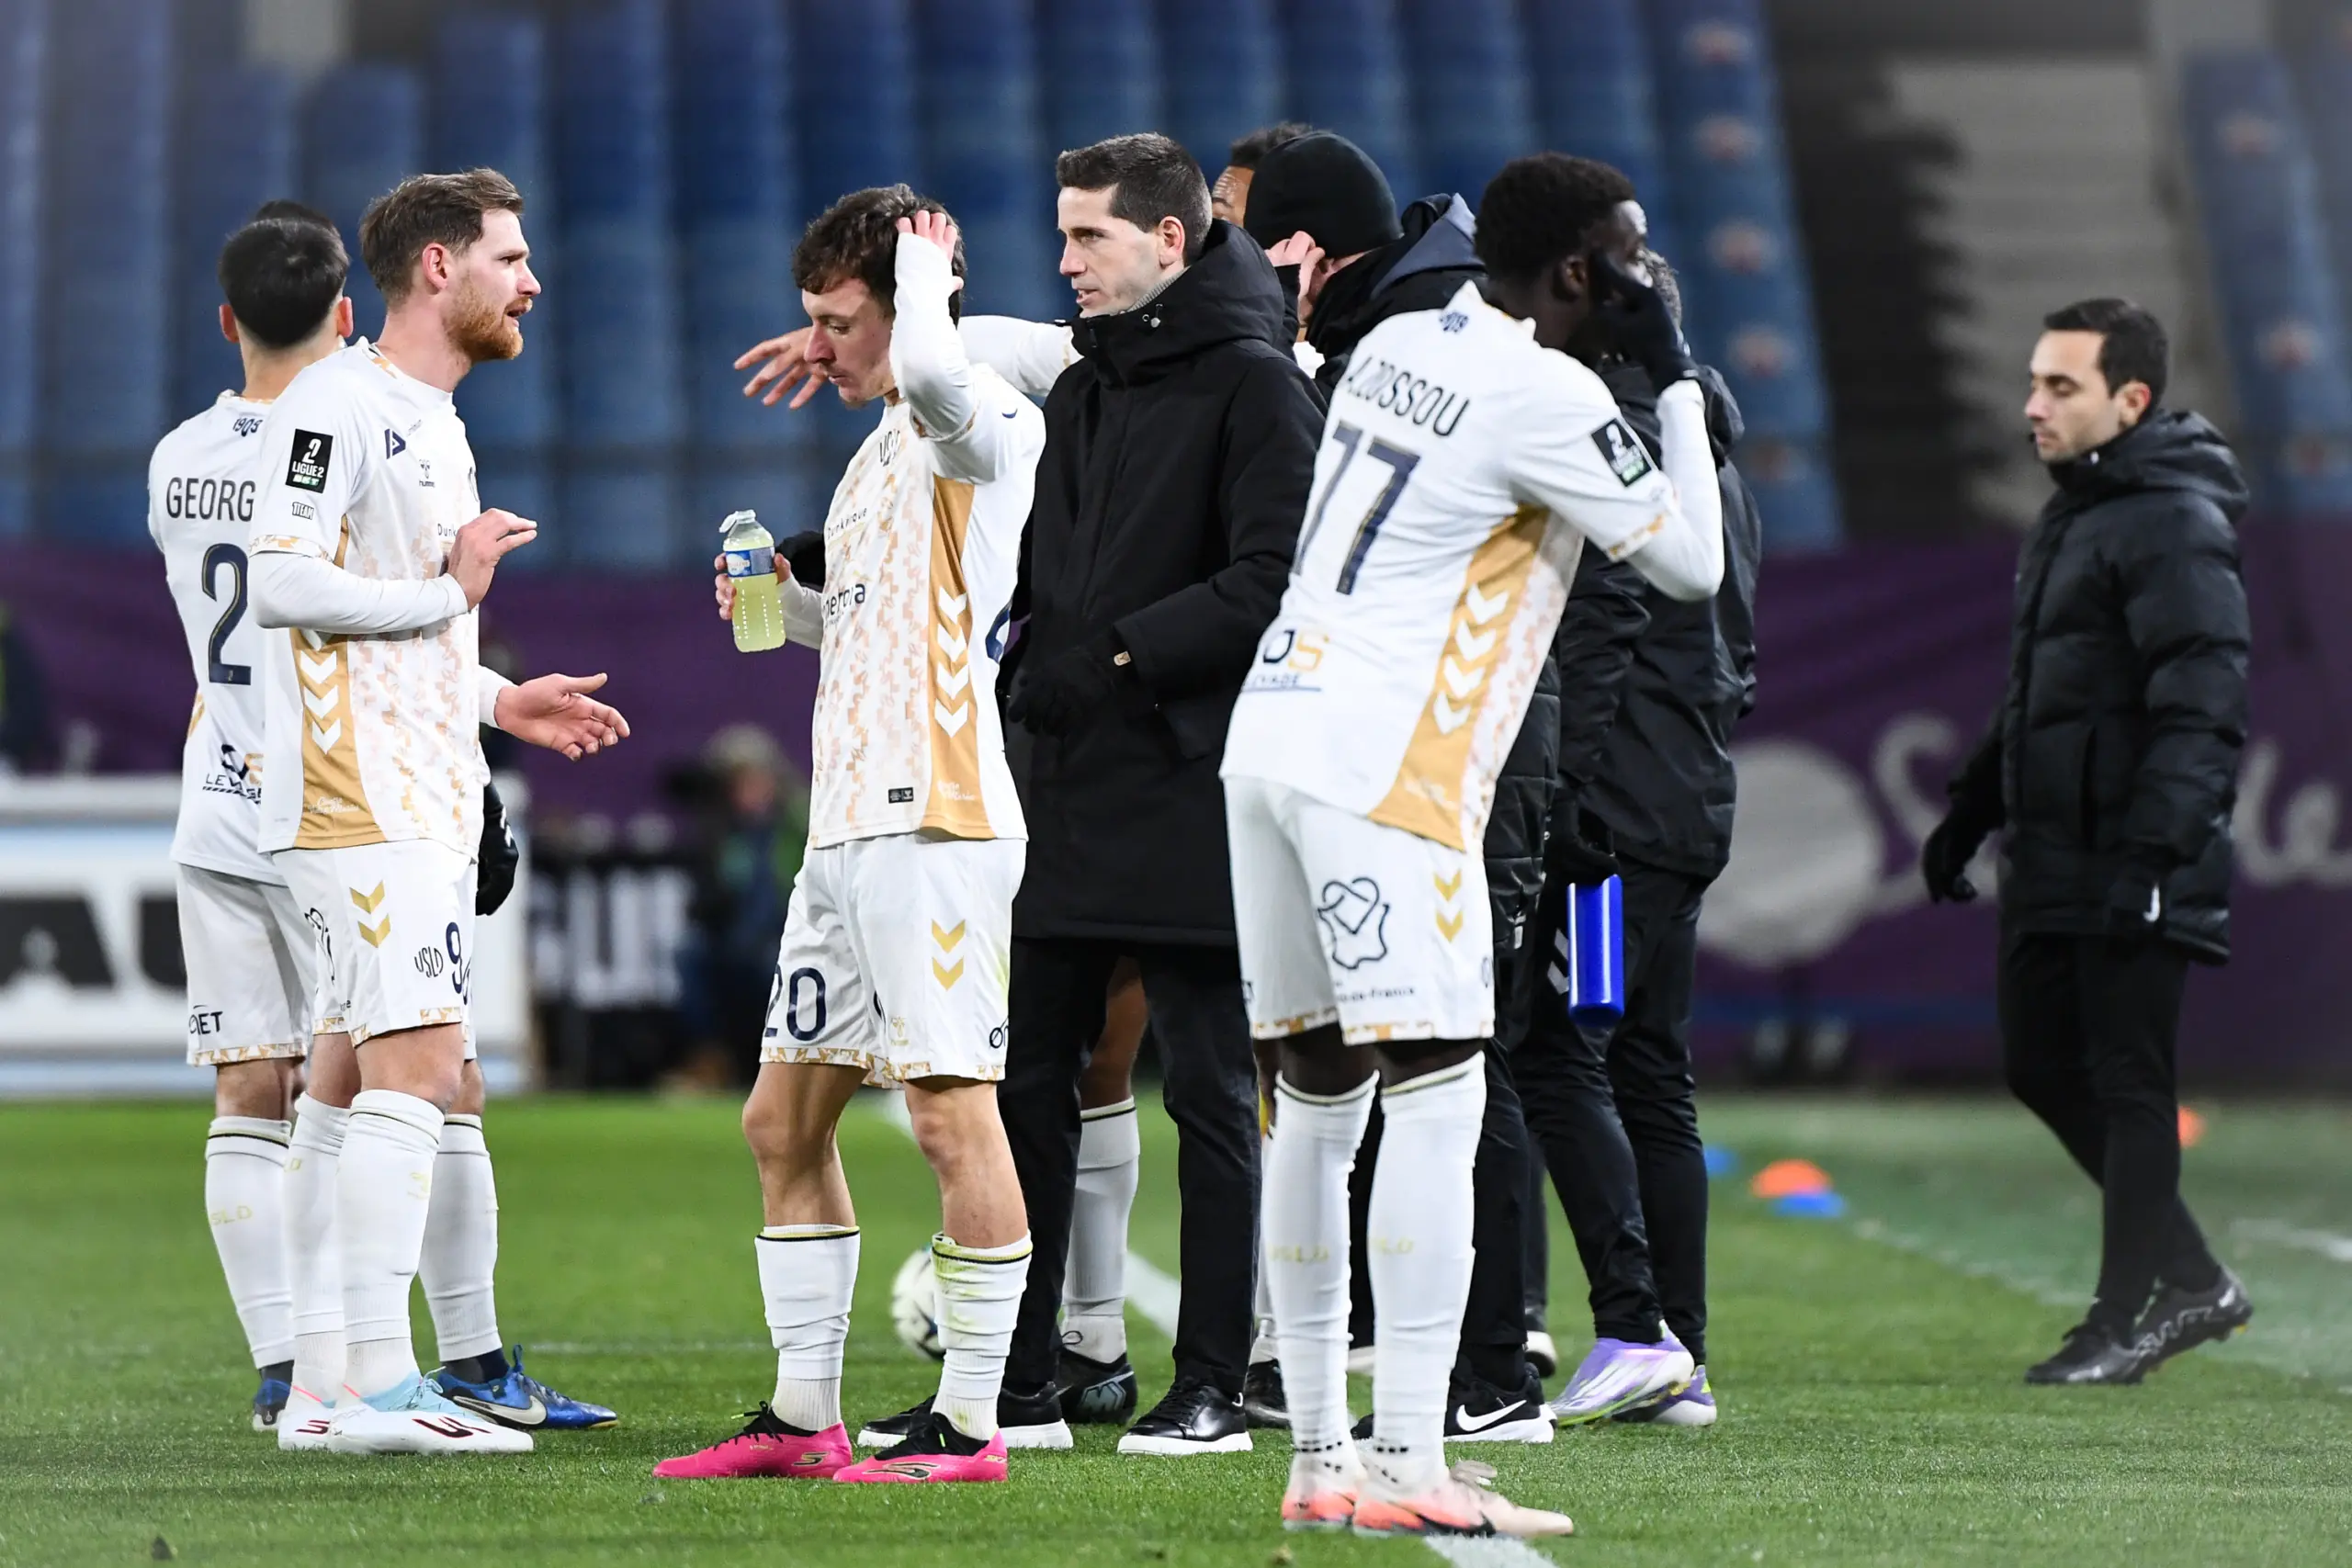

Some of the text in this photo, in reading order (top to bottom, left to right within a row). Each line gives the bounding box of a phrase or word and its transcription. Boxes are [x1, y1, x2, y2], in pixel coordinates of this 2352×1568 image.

[232, 416, 264, 438] 1905
[301, 438, 322, 464] 2
[166, 476, 255, 522] GEORG
[201, 543, 251, 685] 2
[414, 946, 444, 978] USLD
[765, 964, 827, 1042] 20
